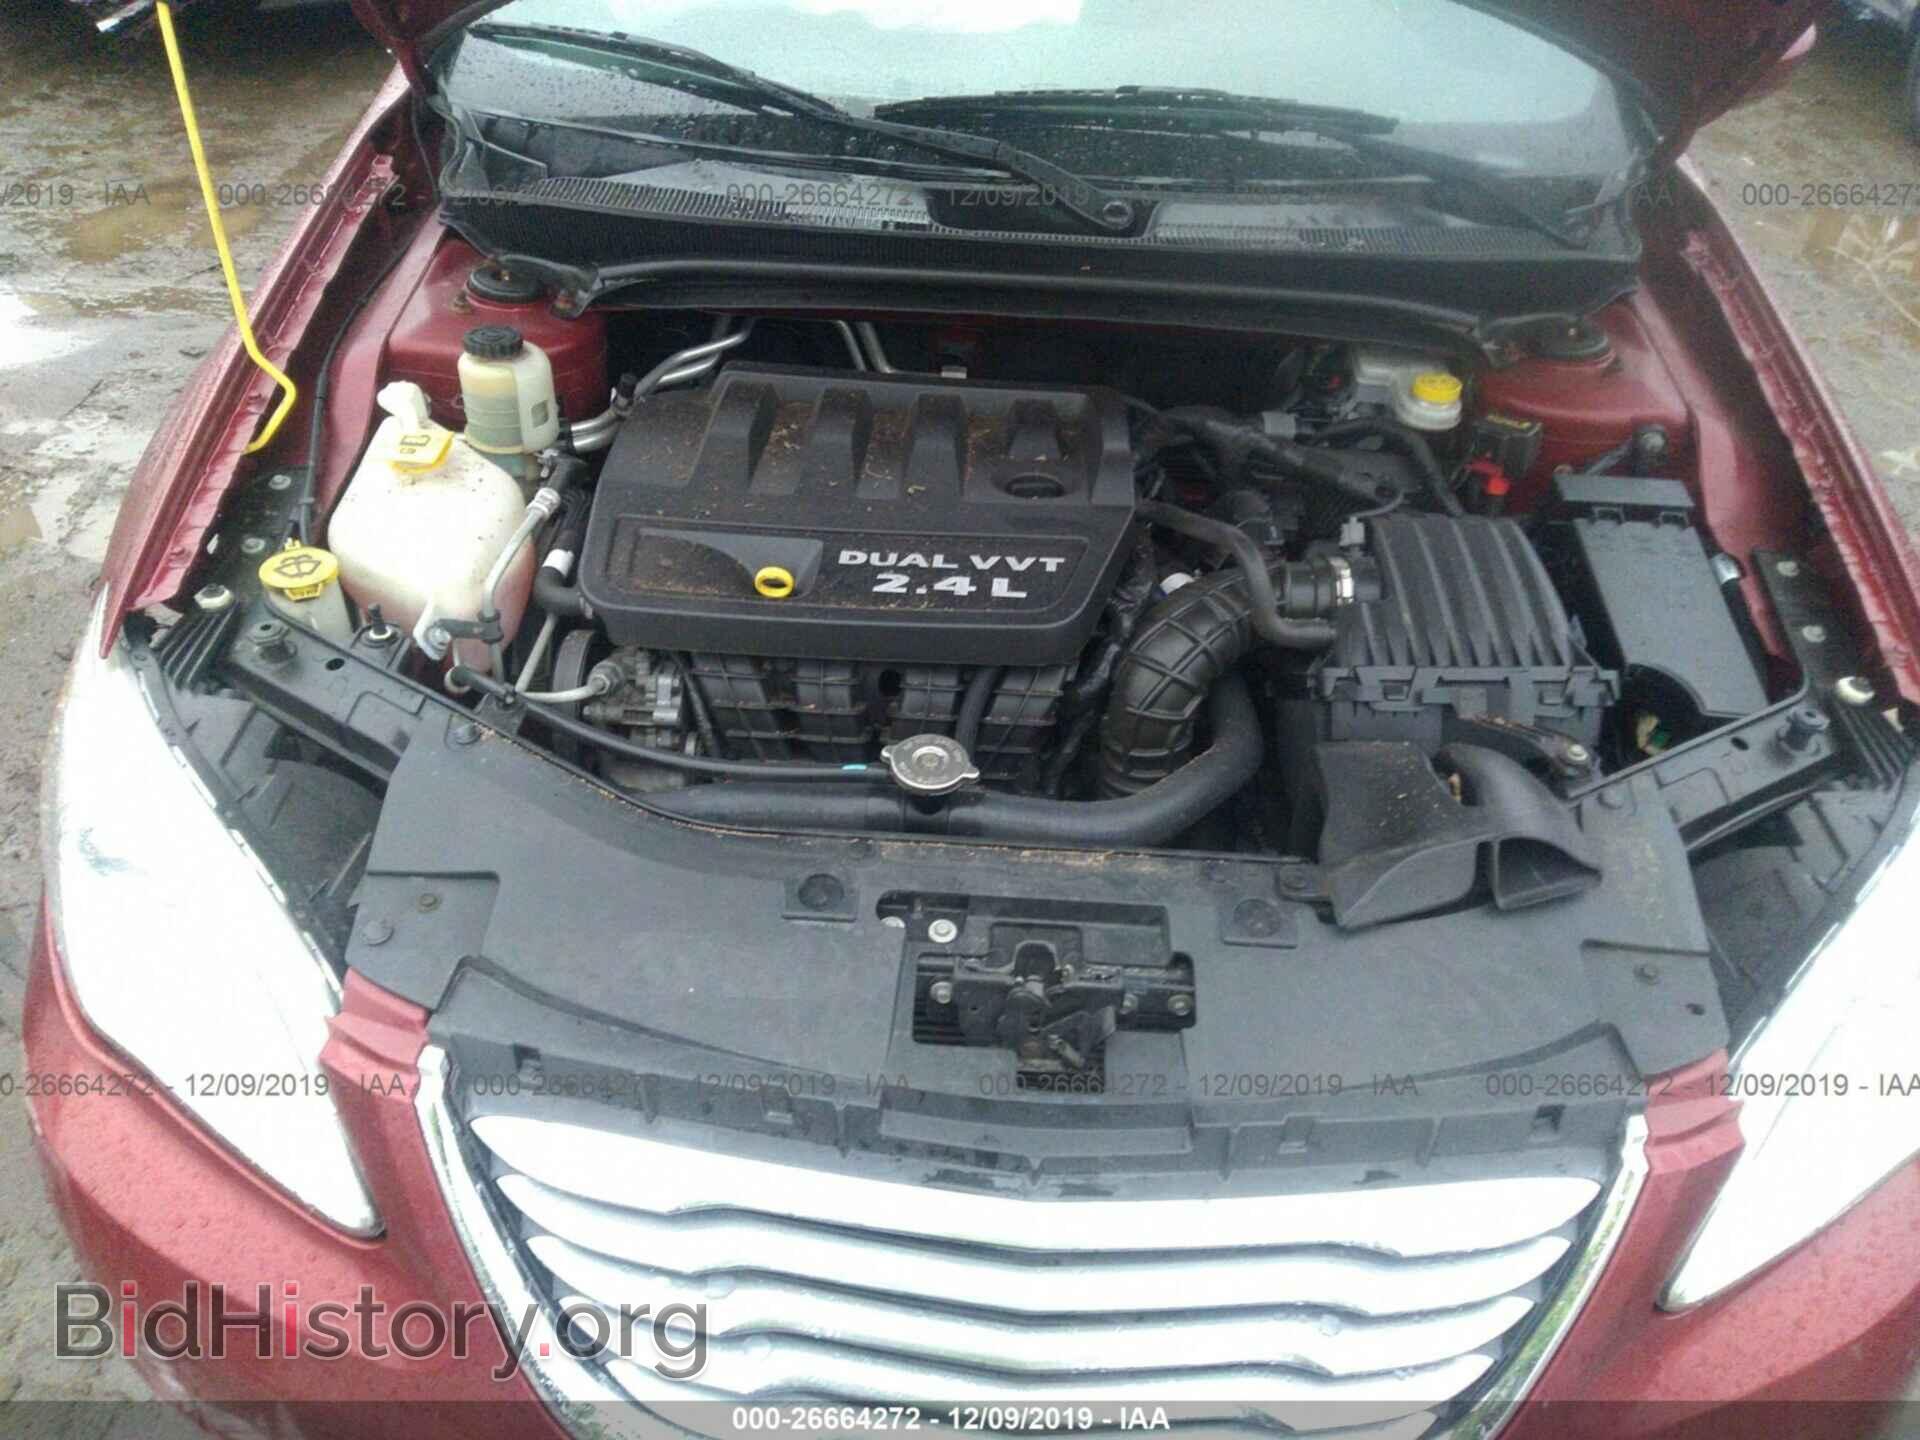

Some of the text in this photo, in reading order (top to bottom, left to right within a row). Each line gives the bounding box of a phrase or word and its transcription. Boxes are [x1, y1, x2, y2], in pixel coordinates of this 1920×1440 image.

[839, 550, 1065, 572] DUAL VVT
[872, 573, 1027, 598] 2.4 L
